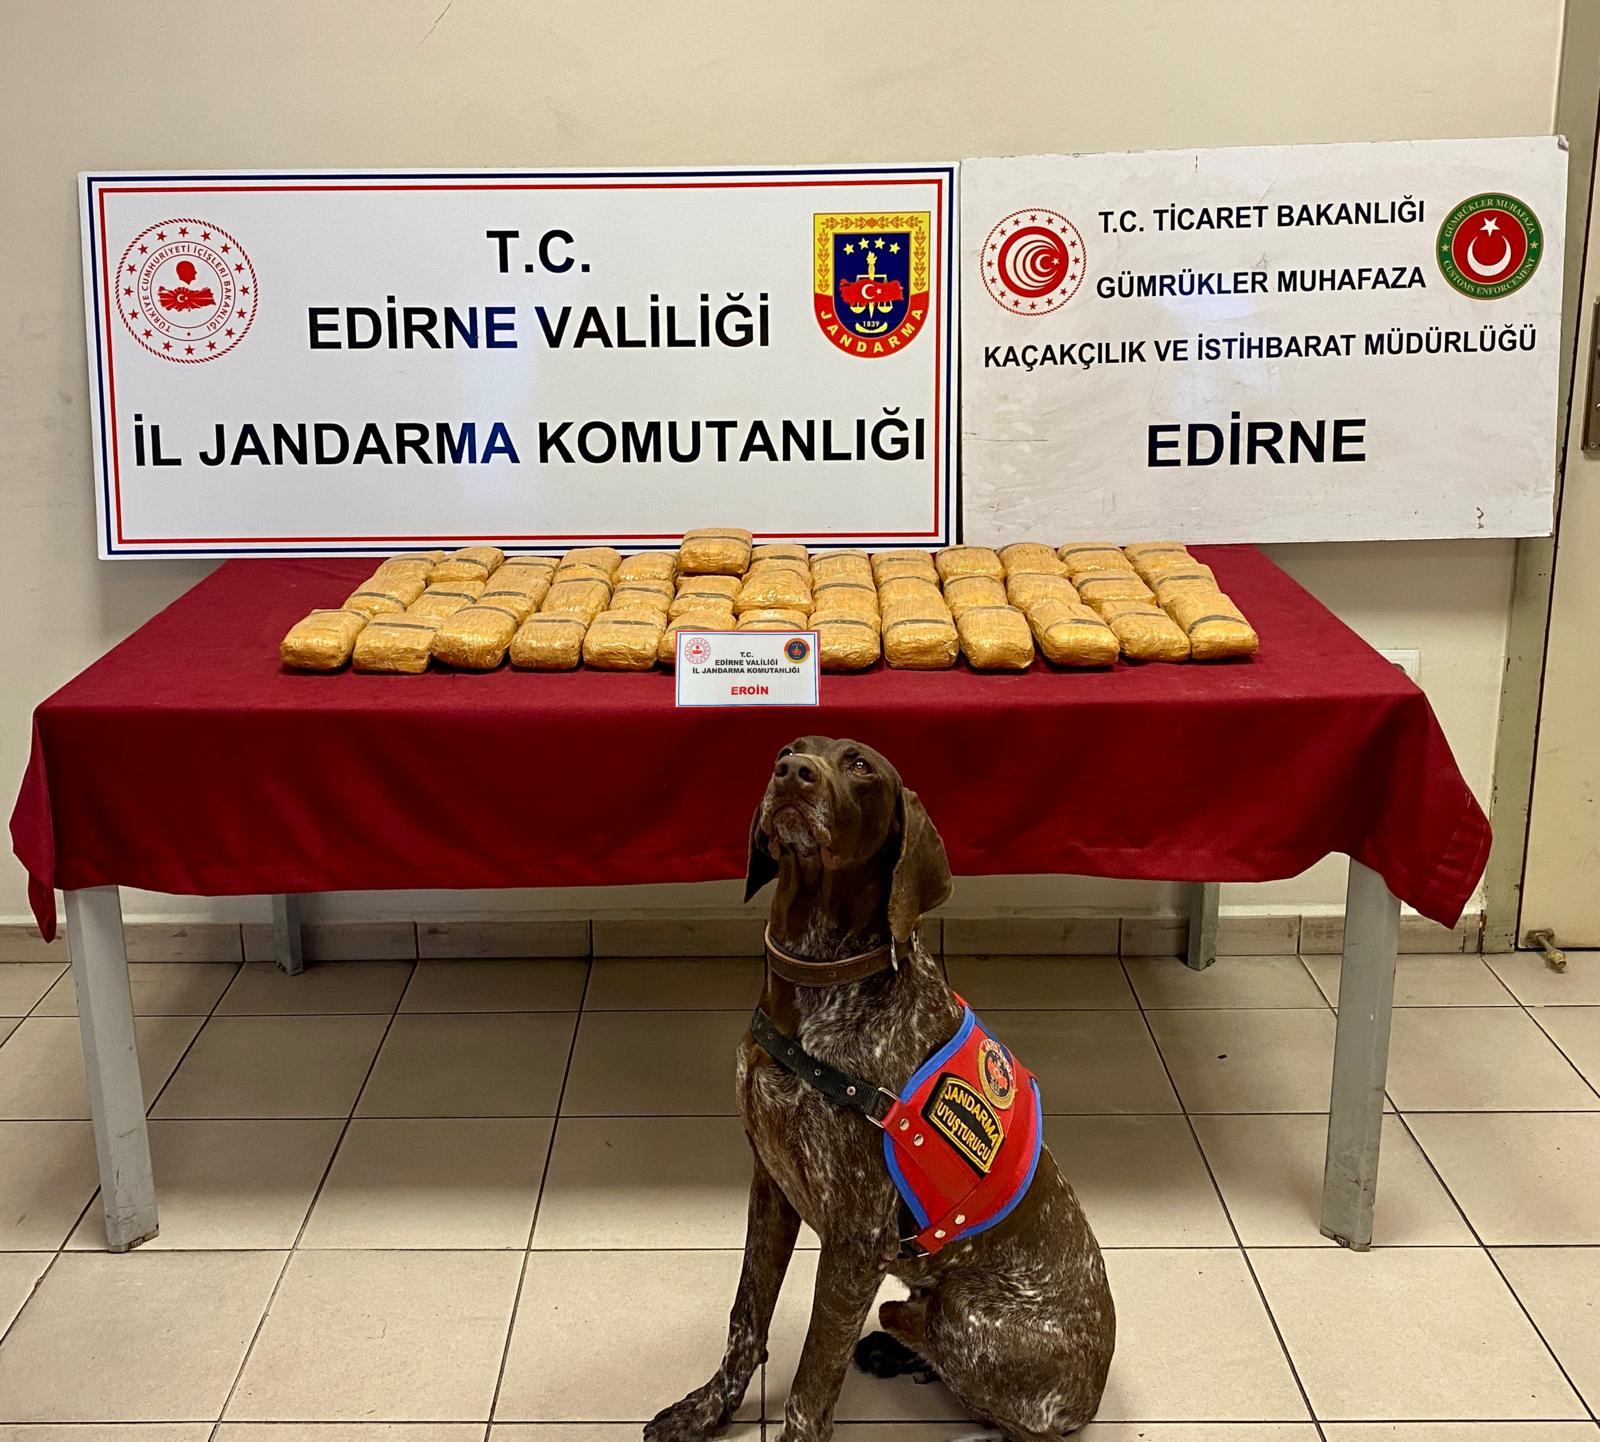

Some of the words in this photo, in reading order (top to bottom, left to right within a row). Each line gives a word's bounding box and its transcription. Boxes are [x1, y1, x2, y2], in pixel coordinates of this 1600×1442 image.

[1099, 210, 1144, 234] T.C.
[1153, 204, 1268, 231] TİCARET
[1278, 195, 1425, 227] BAKANLIĞI
[1445, 199, 1493, 237] GÜMRÜKLER
[1495, 198, 1536, 234] MUHAFAZA
[141, 244, 190, 291] CUMHURİYETİ
[193, 245, 229, 280] İÇİŞLERİ
[487, 230, 590, 274] T.C.
[1097, 269, 1269, 299] GÜMRÜKLER
[1278, 267, 1427, 293] MUHAFAZA
[1443, 260, 1475, 293] CUSTOMS
[1476, 257, 1536, 295] ENFORCEMENT
[206, 280, 232, 332] BAKANLIĞI
[309, 296, 518, 350] EDİRNE
[535, 292, 769, 349] VALİLİĞİ
[862, 320, 880, 328] 1839
[820, 309, 924, 353] JANDARMA
[985, 340, 1147, 372] KAÇAKÇILIK
[1154, 340, 1189, 362] VE
[1197, 332, 1357, 361] İSTİHBARAT
[1364, 323, 1536, 356] MÜDÜRLÜĞÜ
[134, 414, 182, 467] İL
[199, 421, 521, 467] JANDARMA
[539, 407, 925, 464] KOMUTANLIĞI
[1147, 411, 1366, 468] EDİRNE
[692, 666, 700, 674] İL
[747, 666, 800, 674] KOMUTANLIĞI
[715, 658, 744, 666] EDİRNE
[745, 658, 778, 666] VALİLİĞİ
[730, 684, 769, 696] EROİN
[937, 1102, 991, 1161] UYUŞTURUCU
[944, 1085, 1000, 1147] JANDARMA
